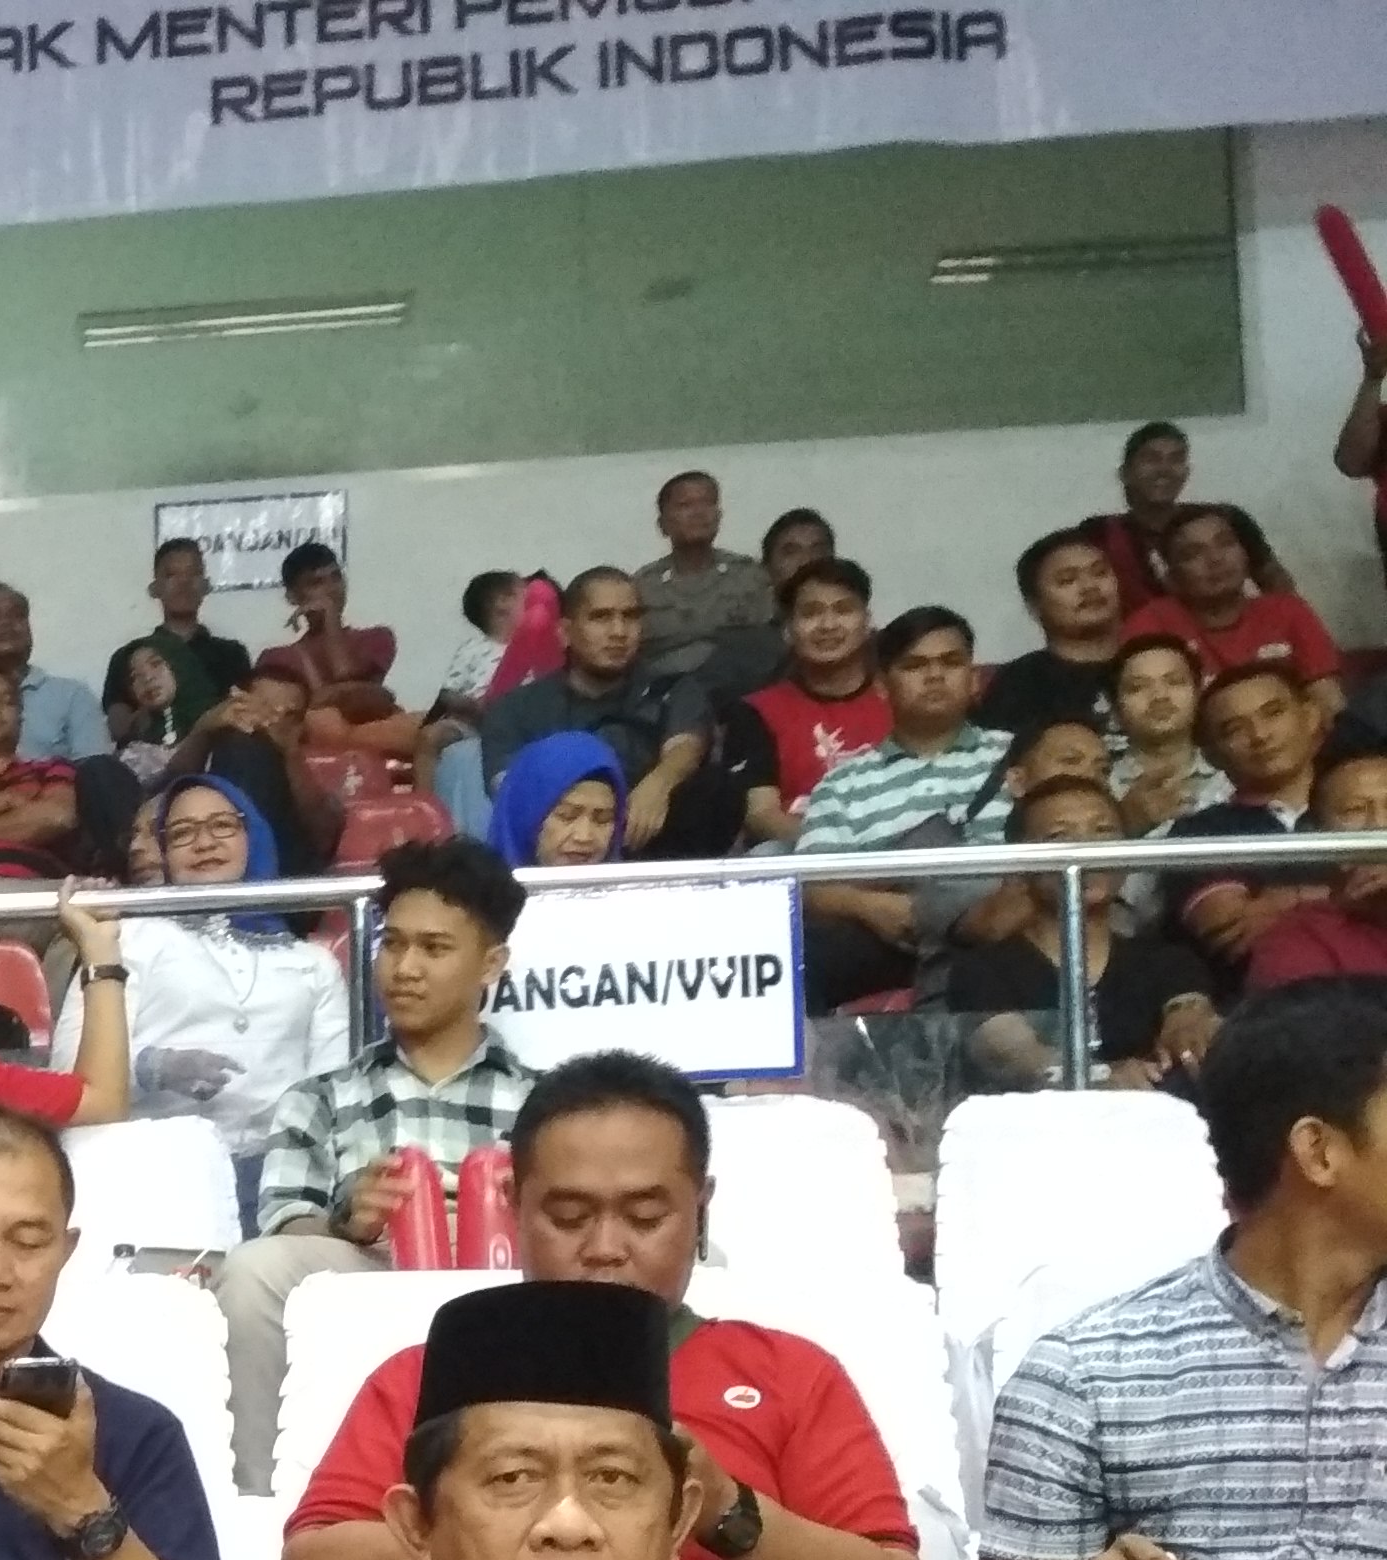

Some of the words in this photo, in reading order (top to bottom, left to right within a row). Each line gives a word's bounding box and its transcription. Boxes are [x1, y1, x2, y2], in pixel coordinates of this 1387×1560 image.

[96, 0, 431, 65] MENTERI
[211, 43, 578, 126] REPUBLIK
[598, 10, 1008, 90] INDONESIA
[480, 953, 784, 1014] ANGAN/VVIP
